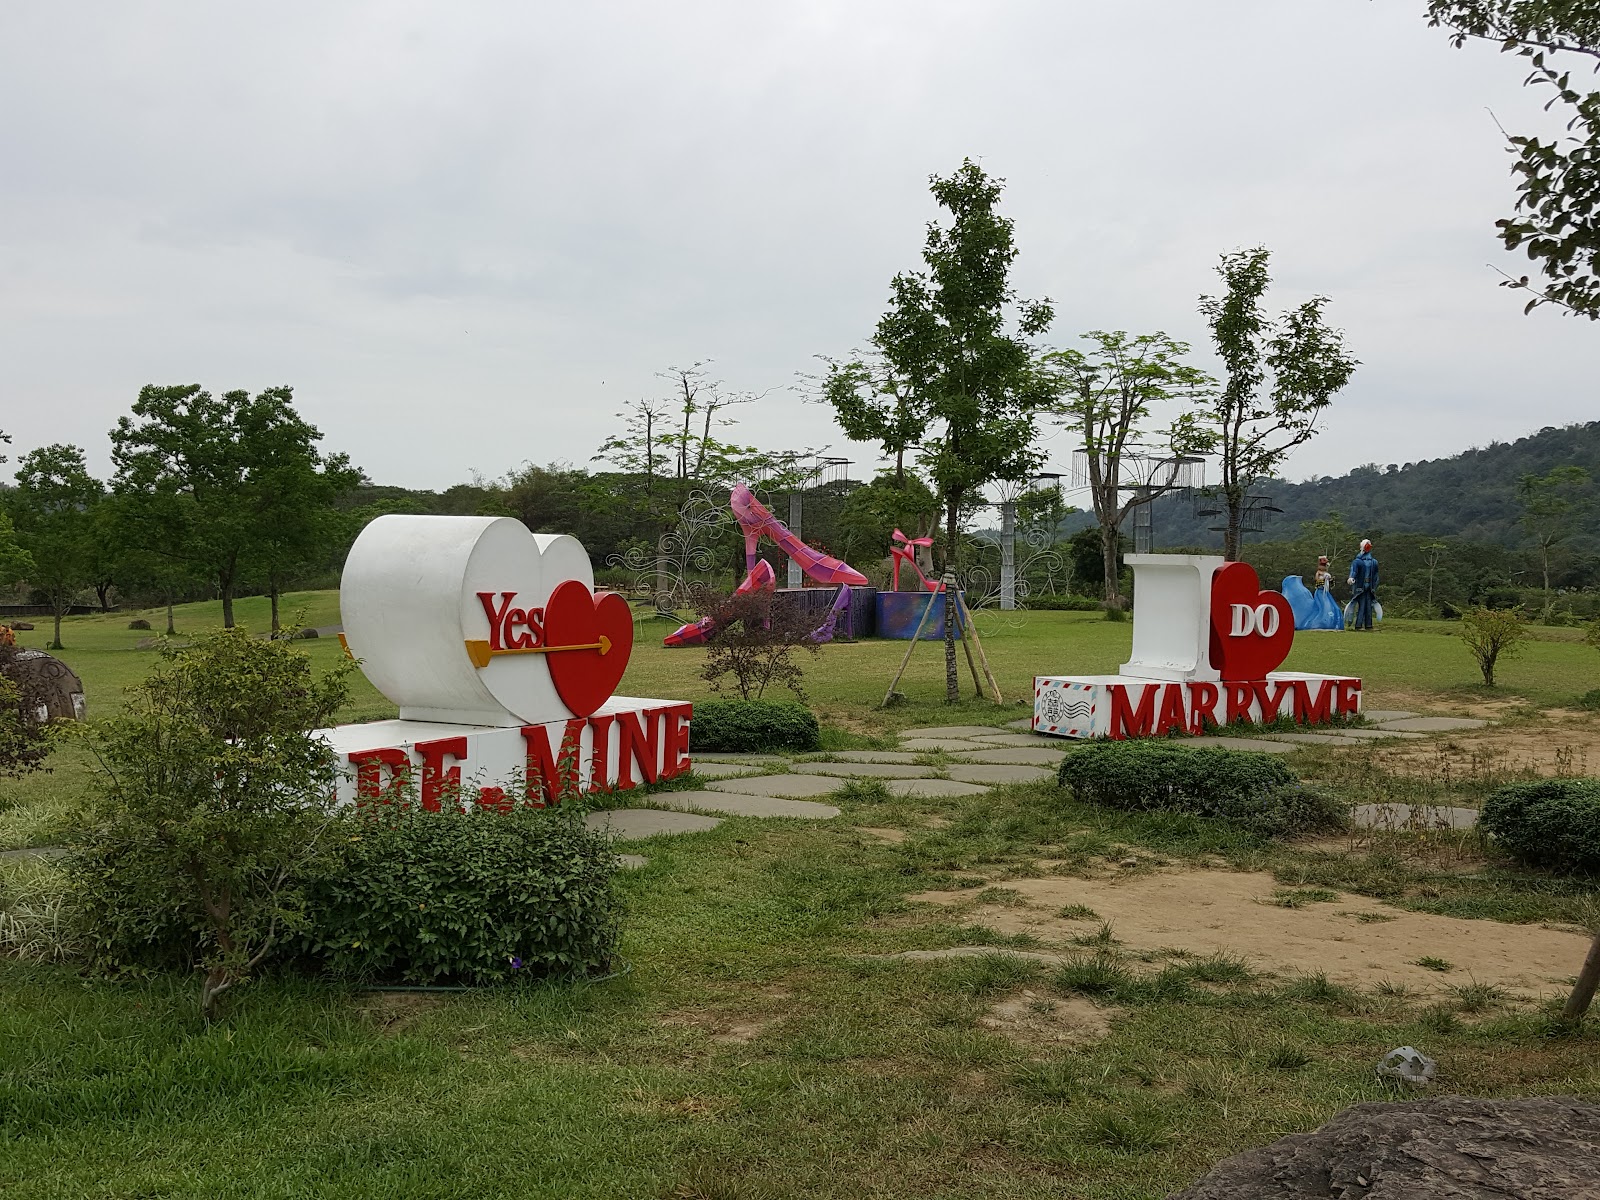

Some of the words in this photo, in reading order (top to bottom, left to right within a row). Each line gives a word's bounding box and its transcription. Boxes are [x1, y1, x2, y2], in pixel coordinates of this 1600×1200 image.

[477, 592, 544, 651] Yes
[1229, 603, 1280, 638] DO
[520, 703, 693, 809] MINE
